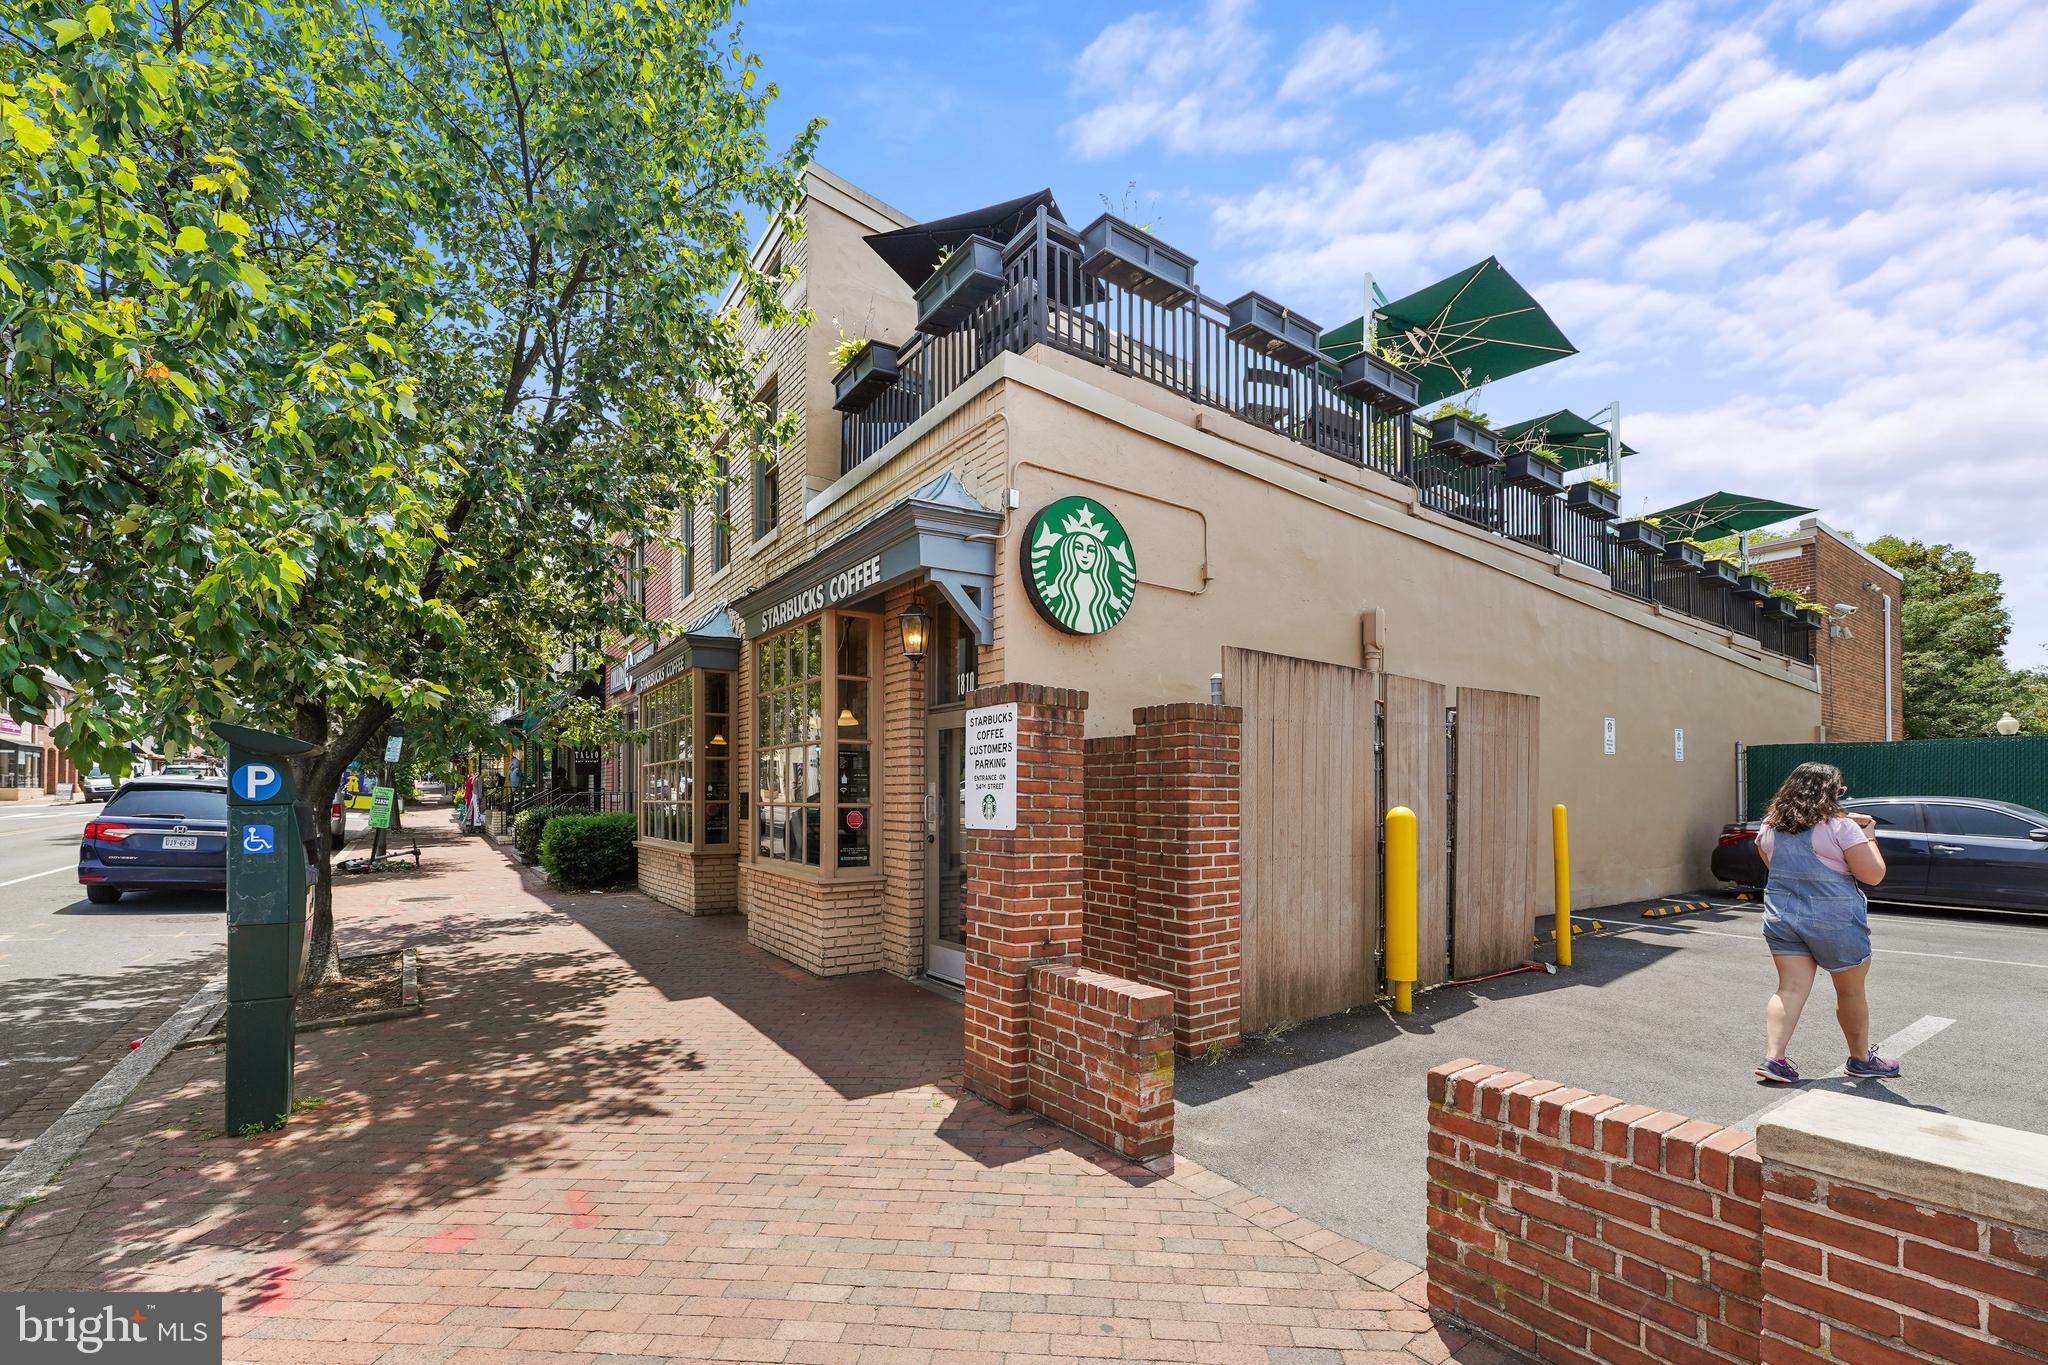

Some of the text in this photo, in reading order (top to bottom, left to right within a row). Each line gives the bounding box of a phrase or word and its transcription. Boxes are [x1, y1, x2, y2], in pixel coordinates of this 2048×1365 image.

[761, 555, 880, 632] STARBUCKS COFFEE
[640, 667, 665, 692] STARBUCKS
[666, 655, 685, 678] COFFEE
[957, 672, 975, 696] 1810
[970, 712, 1013, 727] STARBUCKS
[977, 728, 1004, 740] COFFEE
[969, 742, 1013, 755] CUSTOMERS
[975, 758, 1006, 769] PARKING
[247, 765, 275, 798] P
[988, 782, 1004, 790] STREET
